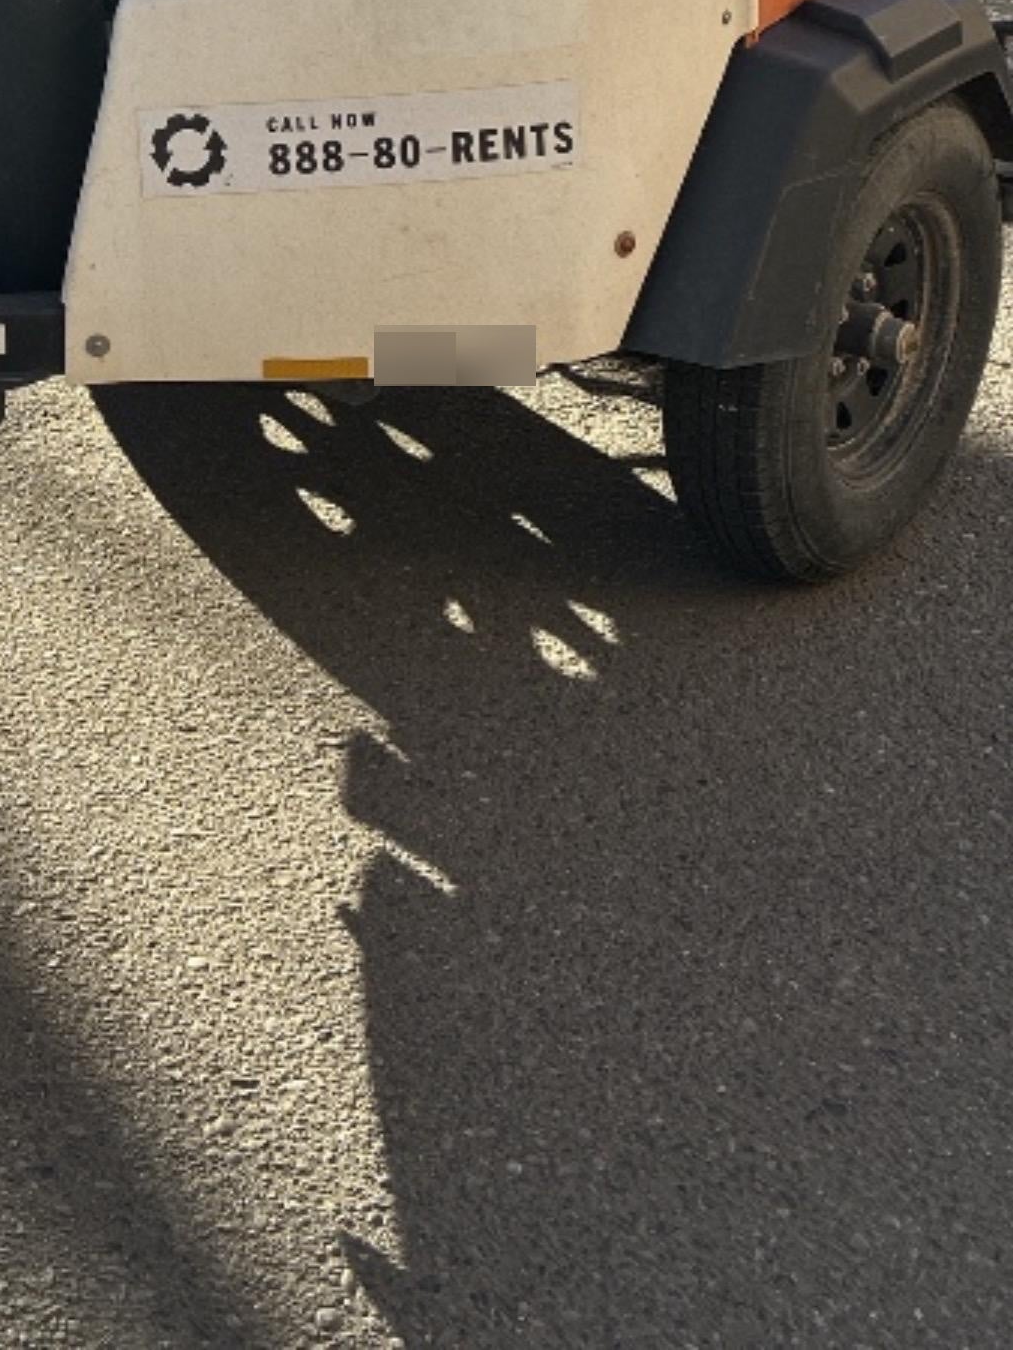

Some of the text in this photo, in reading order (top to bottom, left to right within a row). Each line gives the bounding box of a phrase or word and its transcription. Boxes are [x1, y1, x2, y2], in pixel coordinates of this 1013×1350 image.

[265, 111, 377, 133] CALL NOW
[268, 121, 575, 175] 888-80-RENTS
